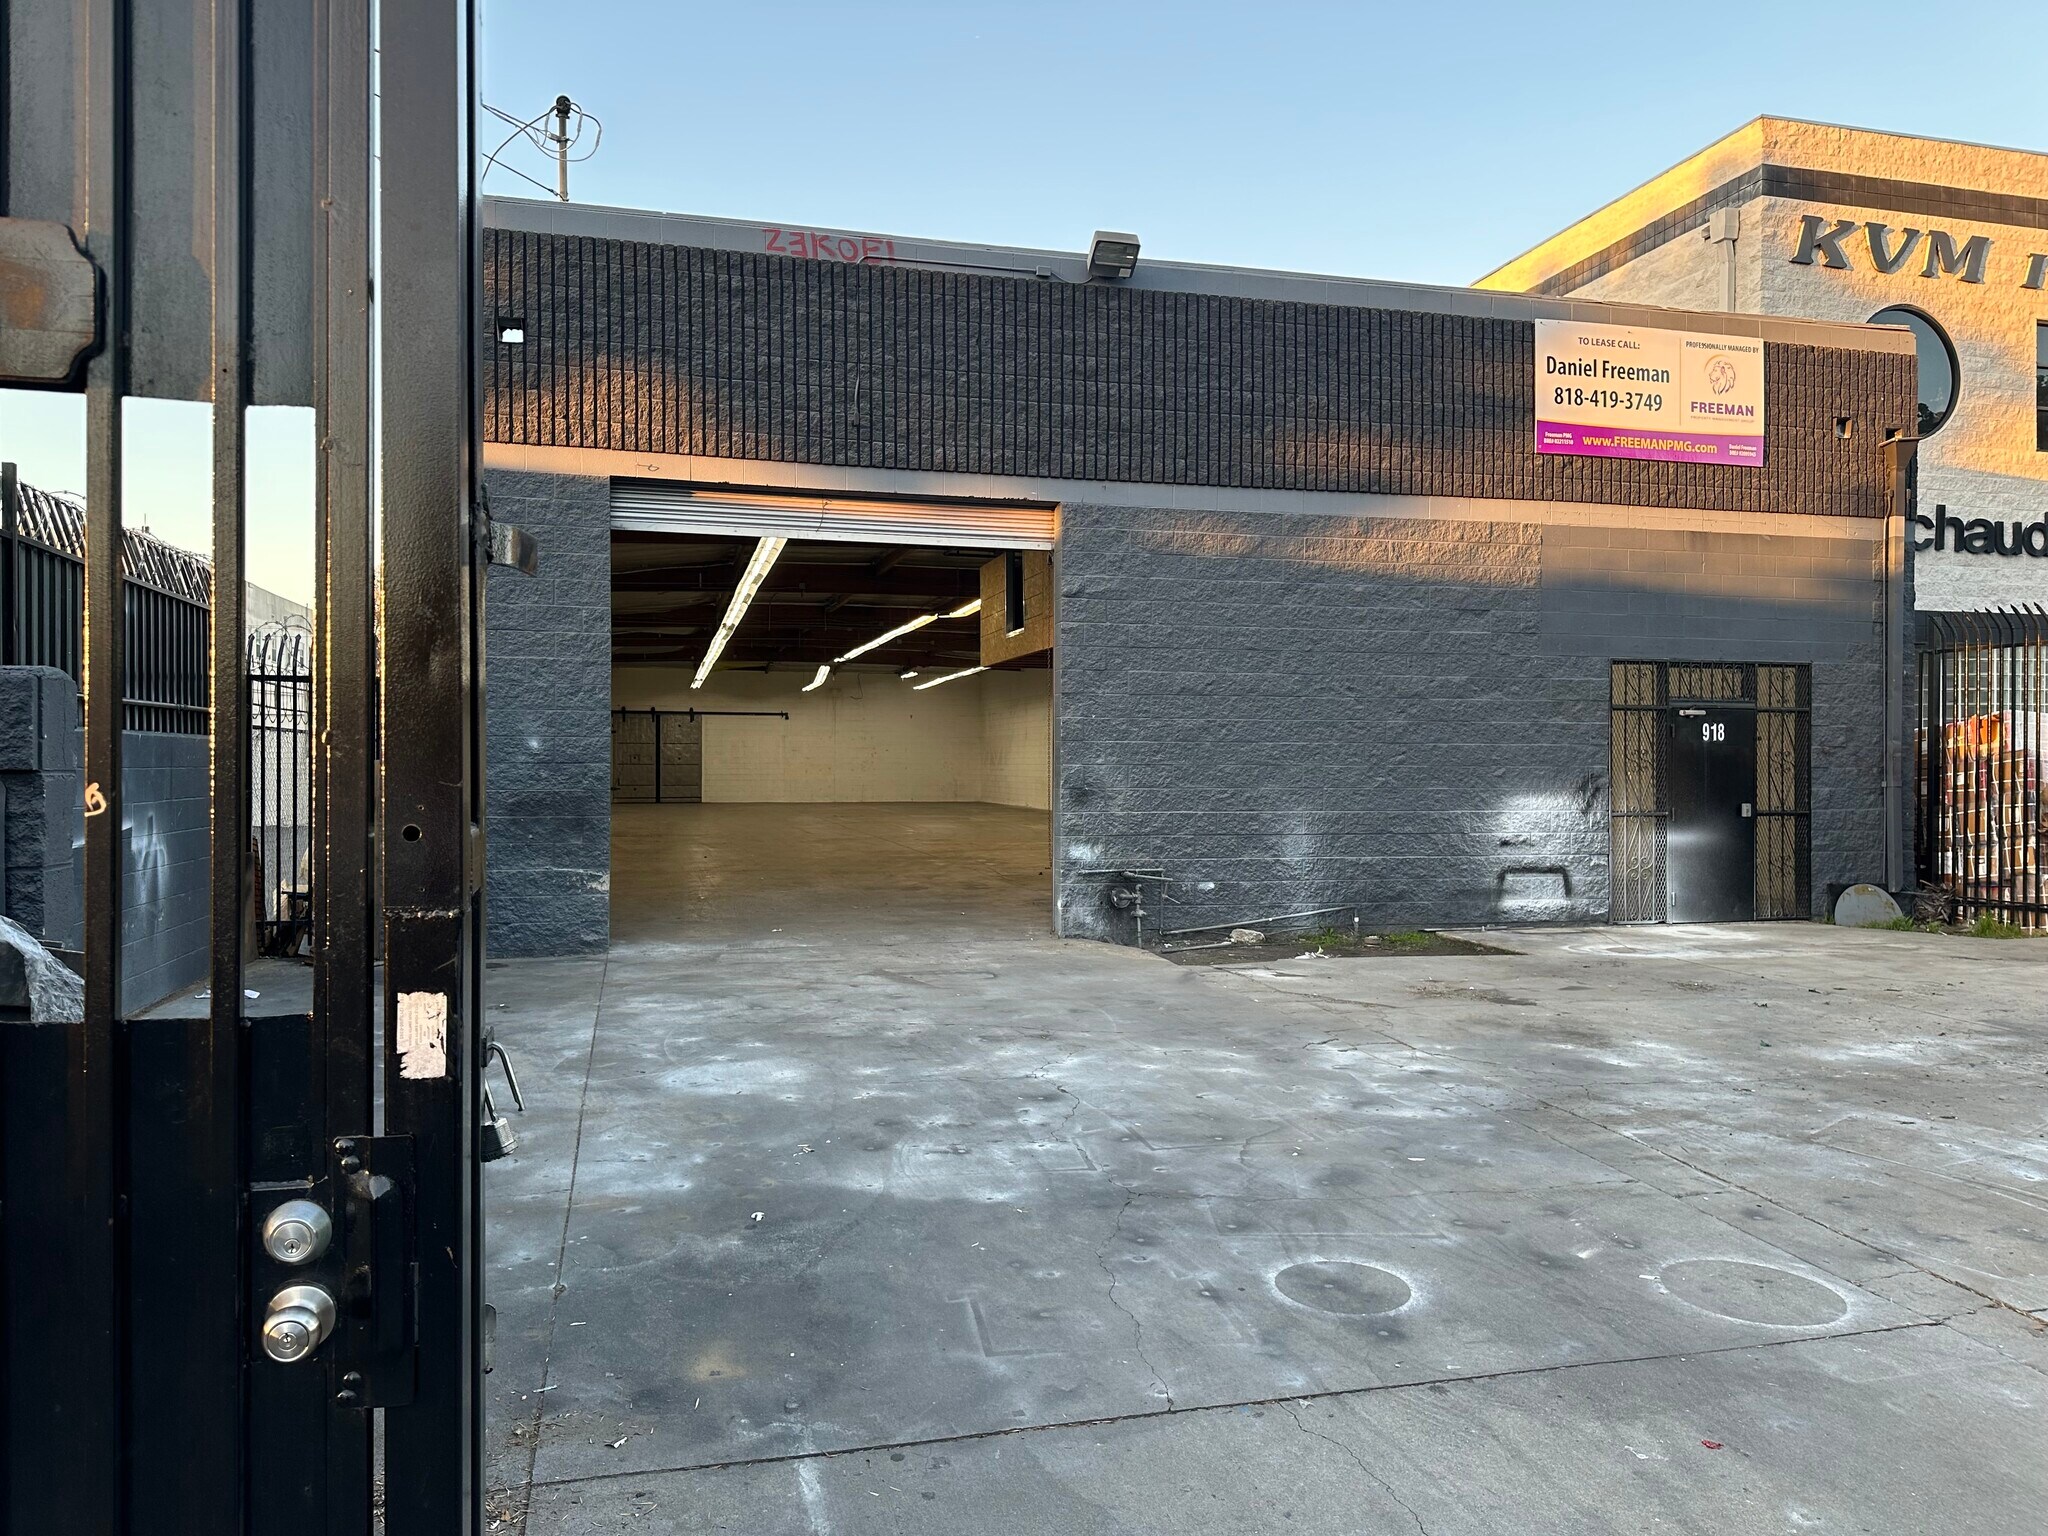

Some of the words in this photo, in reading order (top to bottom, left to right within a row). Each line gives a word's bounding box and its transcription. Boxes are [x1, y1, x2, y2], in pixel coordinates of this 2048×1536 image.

[1788, 214, 1993, 284] KVM
[1578, 337, 1589, 345] TO
[1591, 338, 1616, 347] LEASE
[1617, 340, 1640, 349] CALL:
[1727, 345, 1751, 353] MANAGED
[1546, 356, 1597, 377] Daniel
[1602, 360, 1670, 383] Freeman
[1554, 387, 1662, 411] 818-419-3749
[1691, 401, 1754, 416] FREEMAN
[1583, 435, 1718, 454] www.FREEMANPMG.com
[1702, 722, 1725, 741] 918
